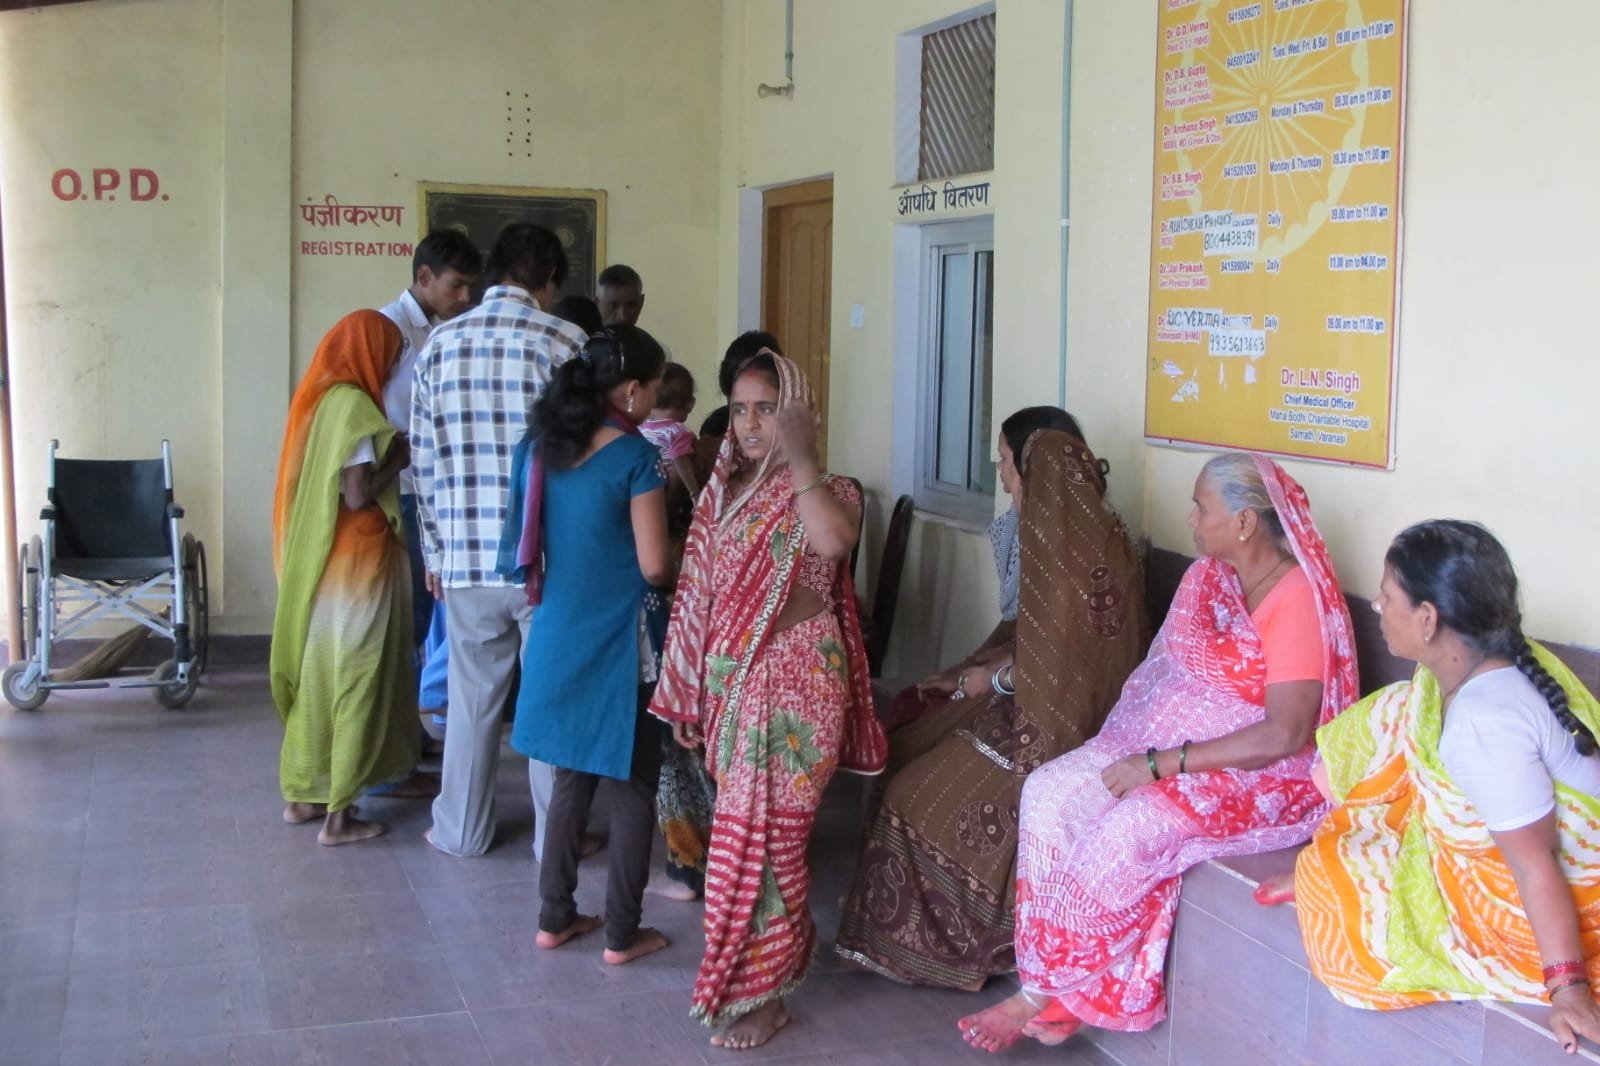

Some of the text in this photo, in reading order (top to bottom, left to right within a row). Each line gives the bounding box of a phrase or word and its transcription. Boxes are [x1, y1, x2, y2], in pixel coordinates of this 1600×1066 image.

[1189, 21, 1209, 33] Verma
[1351, 29, 1361, 41] am
[1383, 22, 1394, 34] am
[1187, 65, 1207, 77] Gupta
[1349, 95, 1359, 105] am
[1381, 88, 1392, 101] am
[1271, 100, 1325, 118] Monday & Thursday
[1163, 118, 1217, 137] Dr. Archana Singh
[1348, 153, 1357, 163] am
[1380, 148, 1391, 160] am
[1269, 157, 1323, 173] Monday & Thursday
[51, 168, 170, 201] O.P.D.
[1184, 171, 1202, 184] Singh
[942, 181, 990, 209] वितरण
[299, 194, 404, 228] पंजीकरण
[1346, 209, 1356, 219] am
[1363, 204, 1379, 217] 11.00
[1379, 206, 1389, 218] am
[1267, 213, 1281, 225] Daily
[301, 240, 413, 257] REGISTRATION
[1159, 262, 1204, 274] Dr. Jai Prakash
[1266, 259, 1280, 272] Daily
[1344, 258, 1354, 268] am
[1377, 257, 1387, 269] pm
[1264, 316, 1278, 330] Daily
[1342, 319, 1352, 330] am
[1374, 320, 1384, 331] am
[1281, 368, 1360, 393] Dr. L.N. Singh
[1284, 393, 1355, 410] Chief Medical Officer
[1288, 410, 1306, 422] Bodhi
[1341, 416, 1370, 430] Hospital
[1318, 431, 1346, 445] Varanasi
